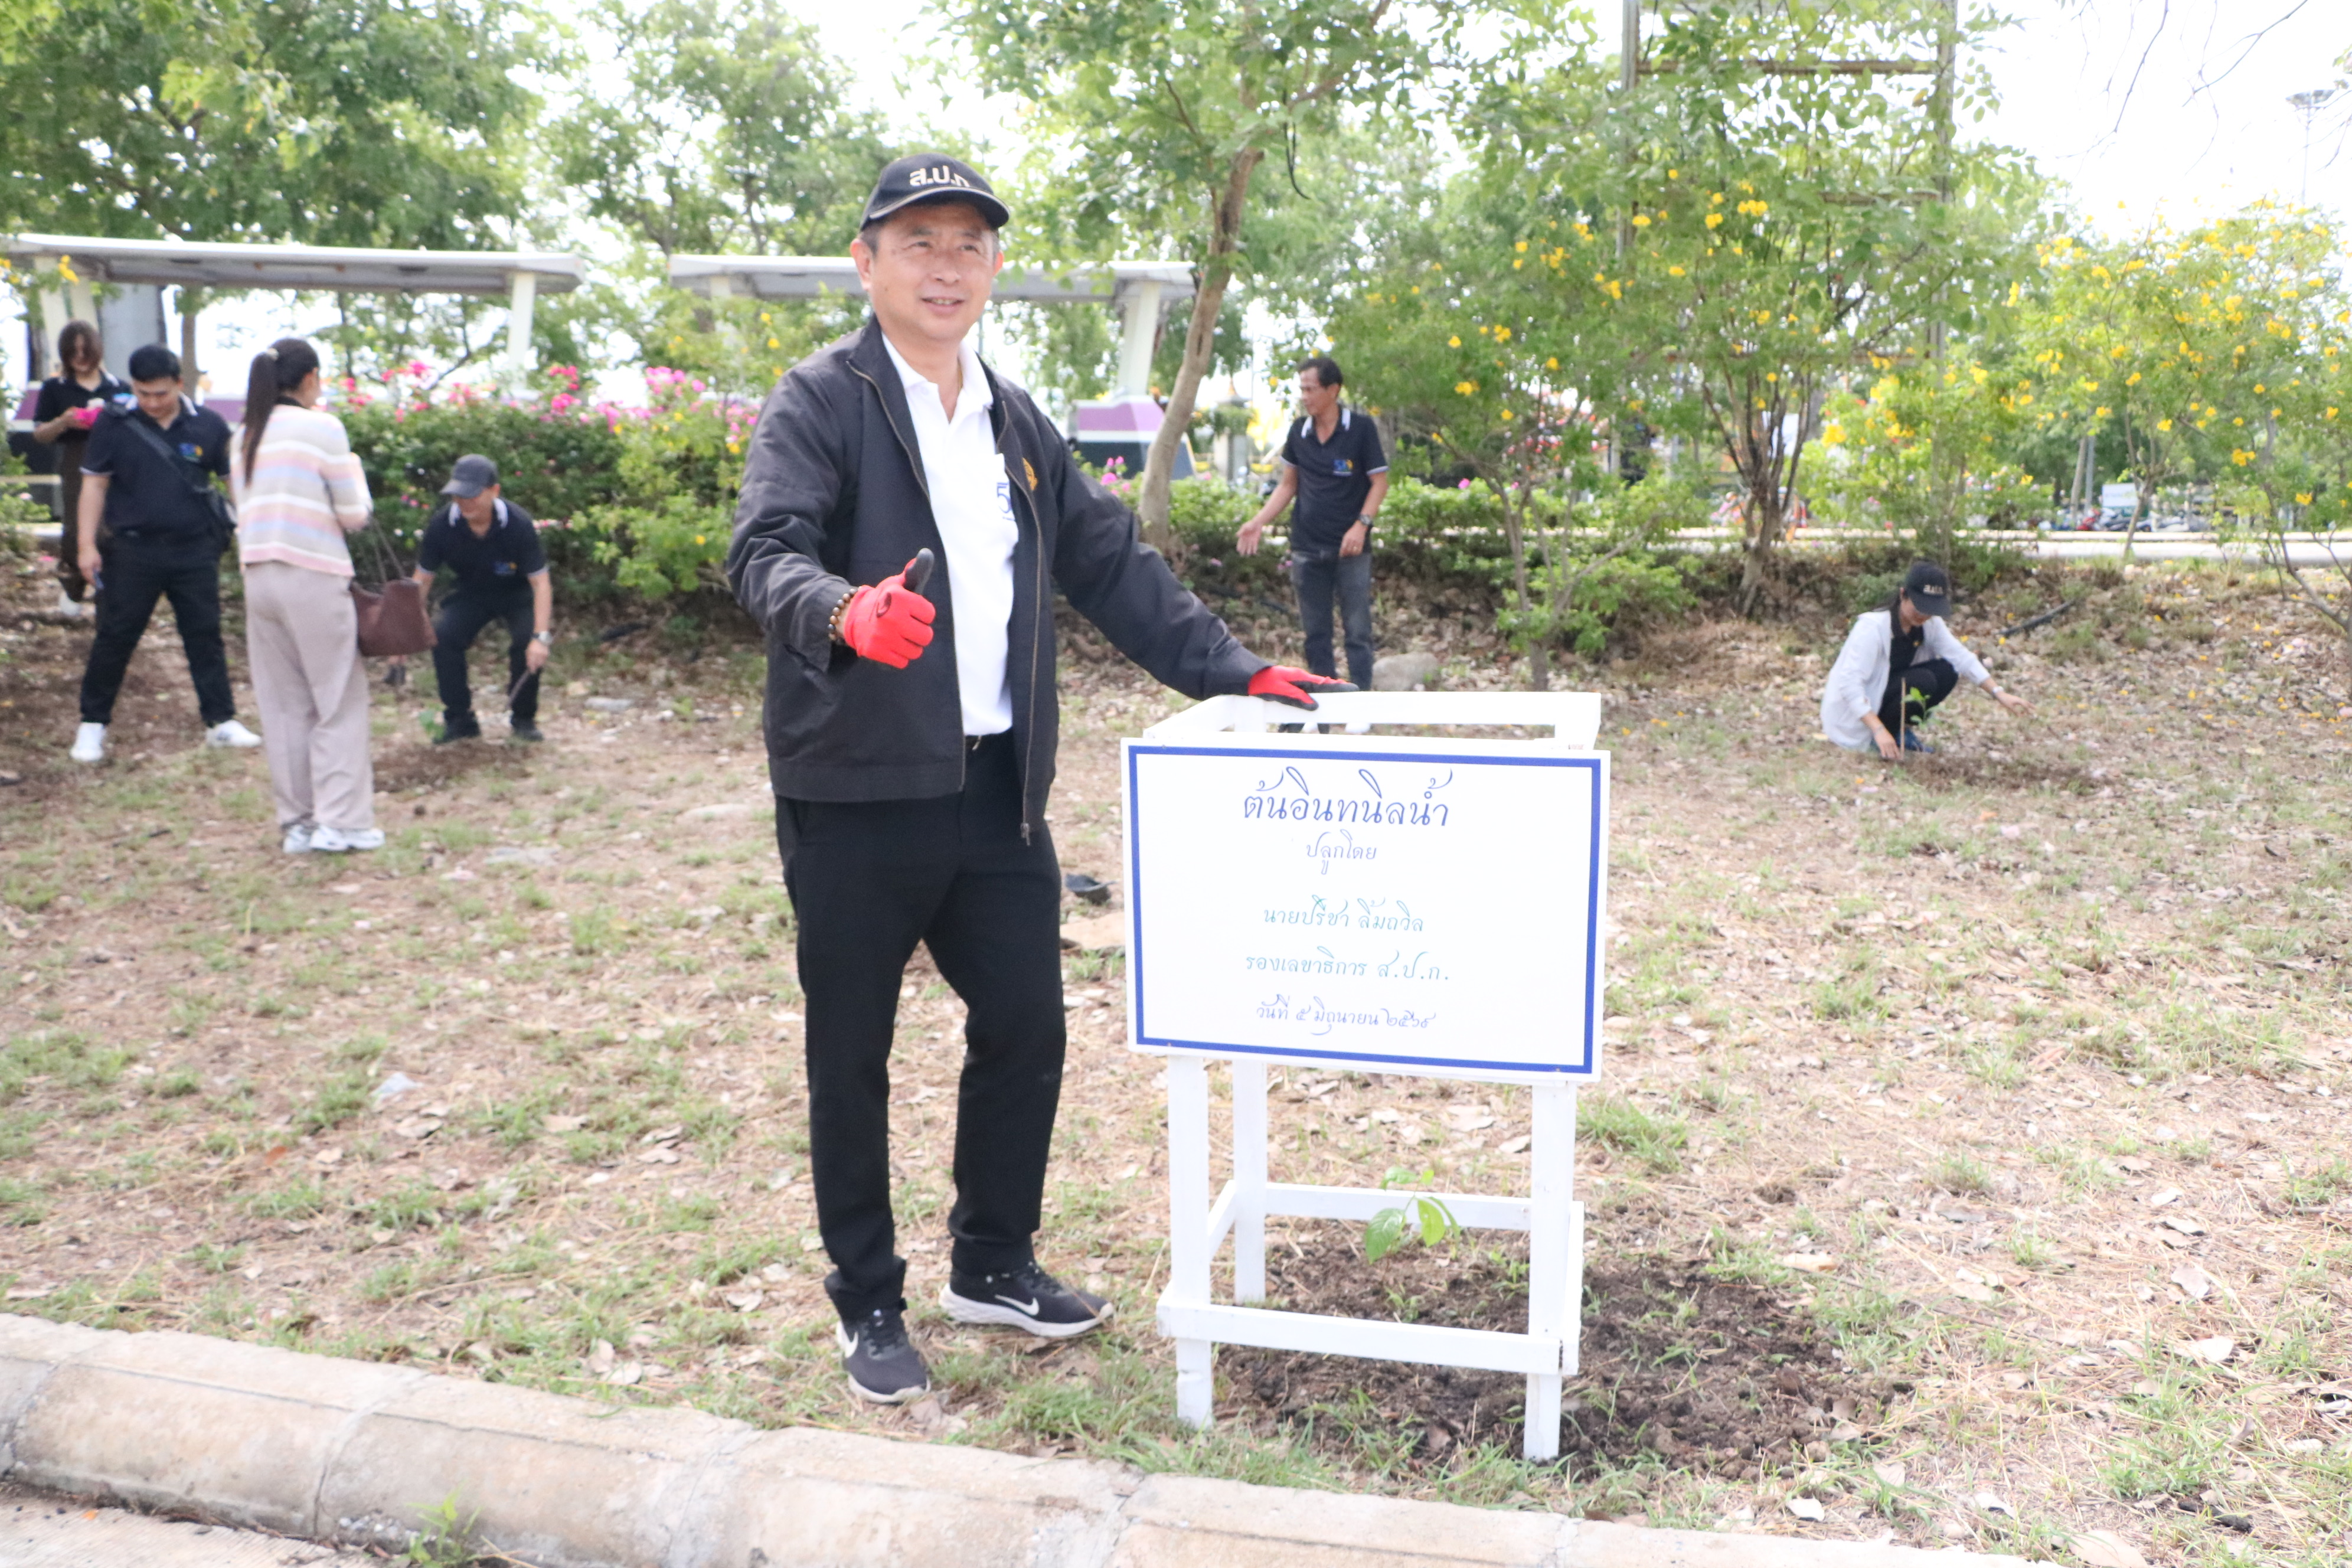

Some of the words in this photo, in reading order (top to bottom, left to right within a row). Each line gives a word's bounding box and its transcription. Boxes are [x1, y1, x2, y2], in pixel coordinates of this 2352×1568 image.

[1244, 766, 1453, 827] ต้นอินทนิลน้ำ
[1306, 828, 1377, 875] ปลูกโดย
[1263, 894, 1350, 928] นายปรีชา
[1357, 898, 1424, 932] ลิ้มถวิล
[1246, 946, 1368, 976] รองเลขาธิการ
[1377, 950, 1449, 980] ส.ป.ก.
[1256, 994, 1291, 1020] วันที่
[1296, 1005, 1311, 1021] ๕
[1311, 996, 1379, 1036] มิถุนายน
[1380, 1008, 1436, 1029] ๒๕๖๙
